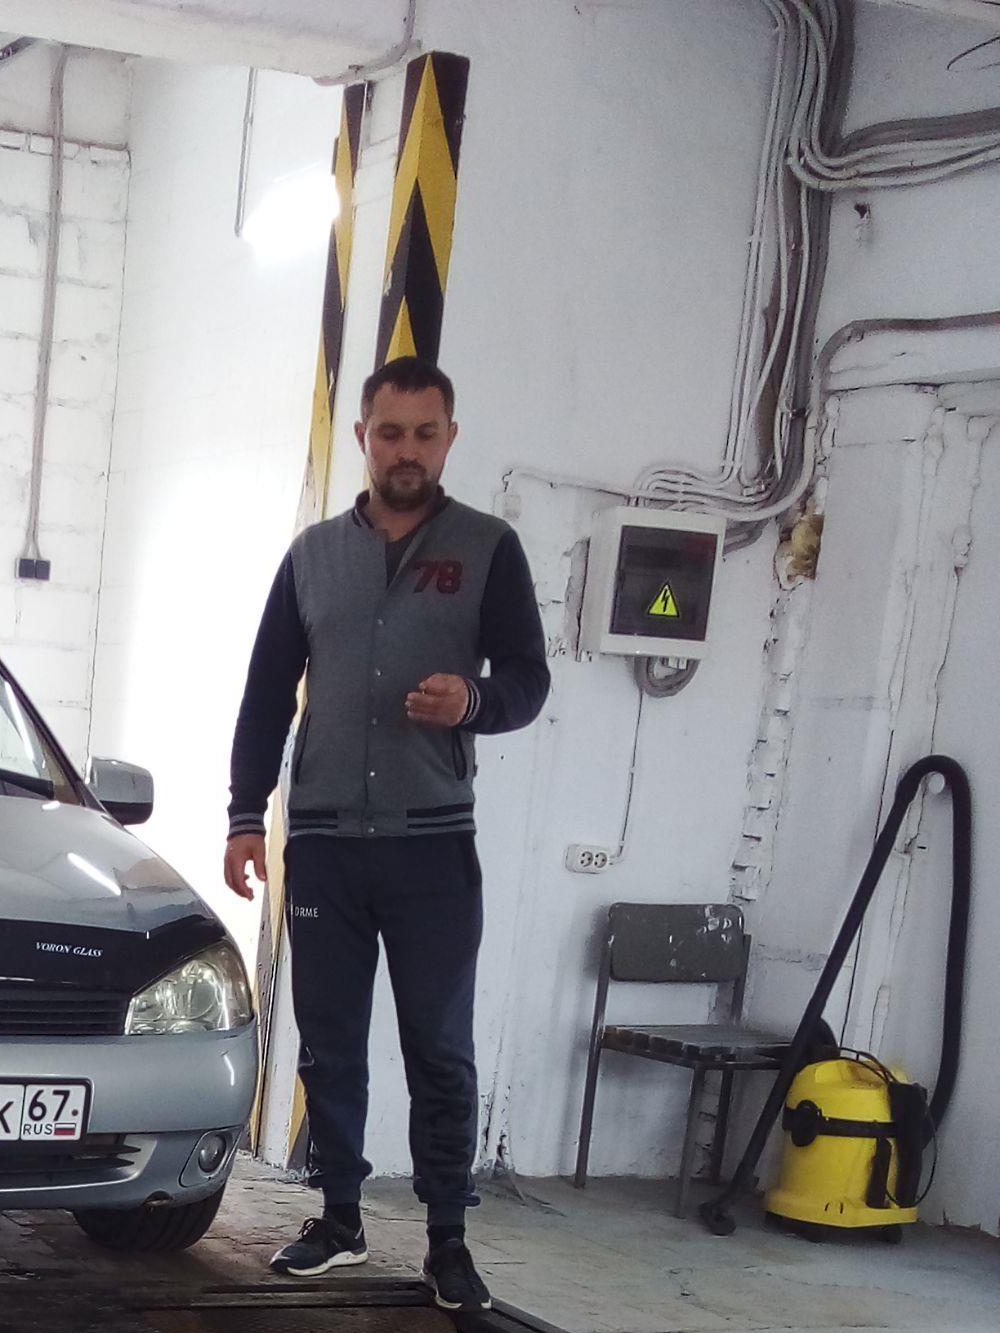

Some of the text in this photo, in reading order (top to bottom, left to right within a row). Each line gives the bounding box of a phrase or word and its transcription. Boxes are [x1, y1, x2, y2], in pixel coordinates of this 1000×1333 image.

[412, 559, 464, 594] 78
[36, 941, 103, 957] VORON GLASS
[27, 1089, 71, 1122] 67
[22, 1123, 53, 1136] RUS
